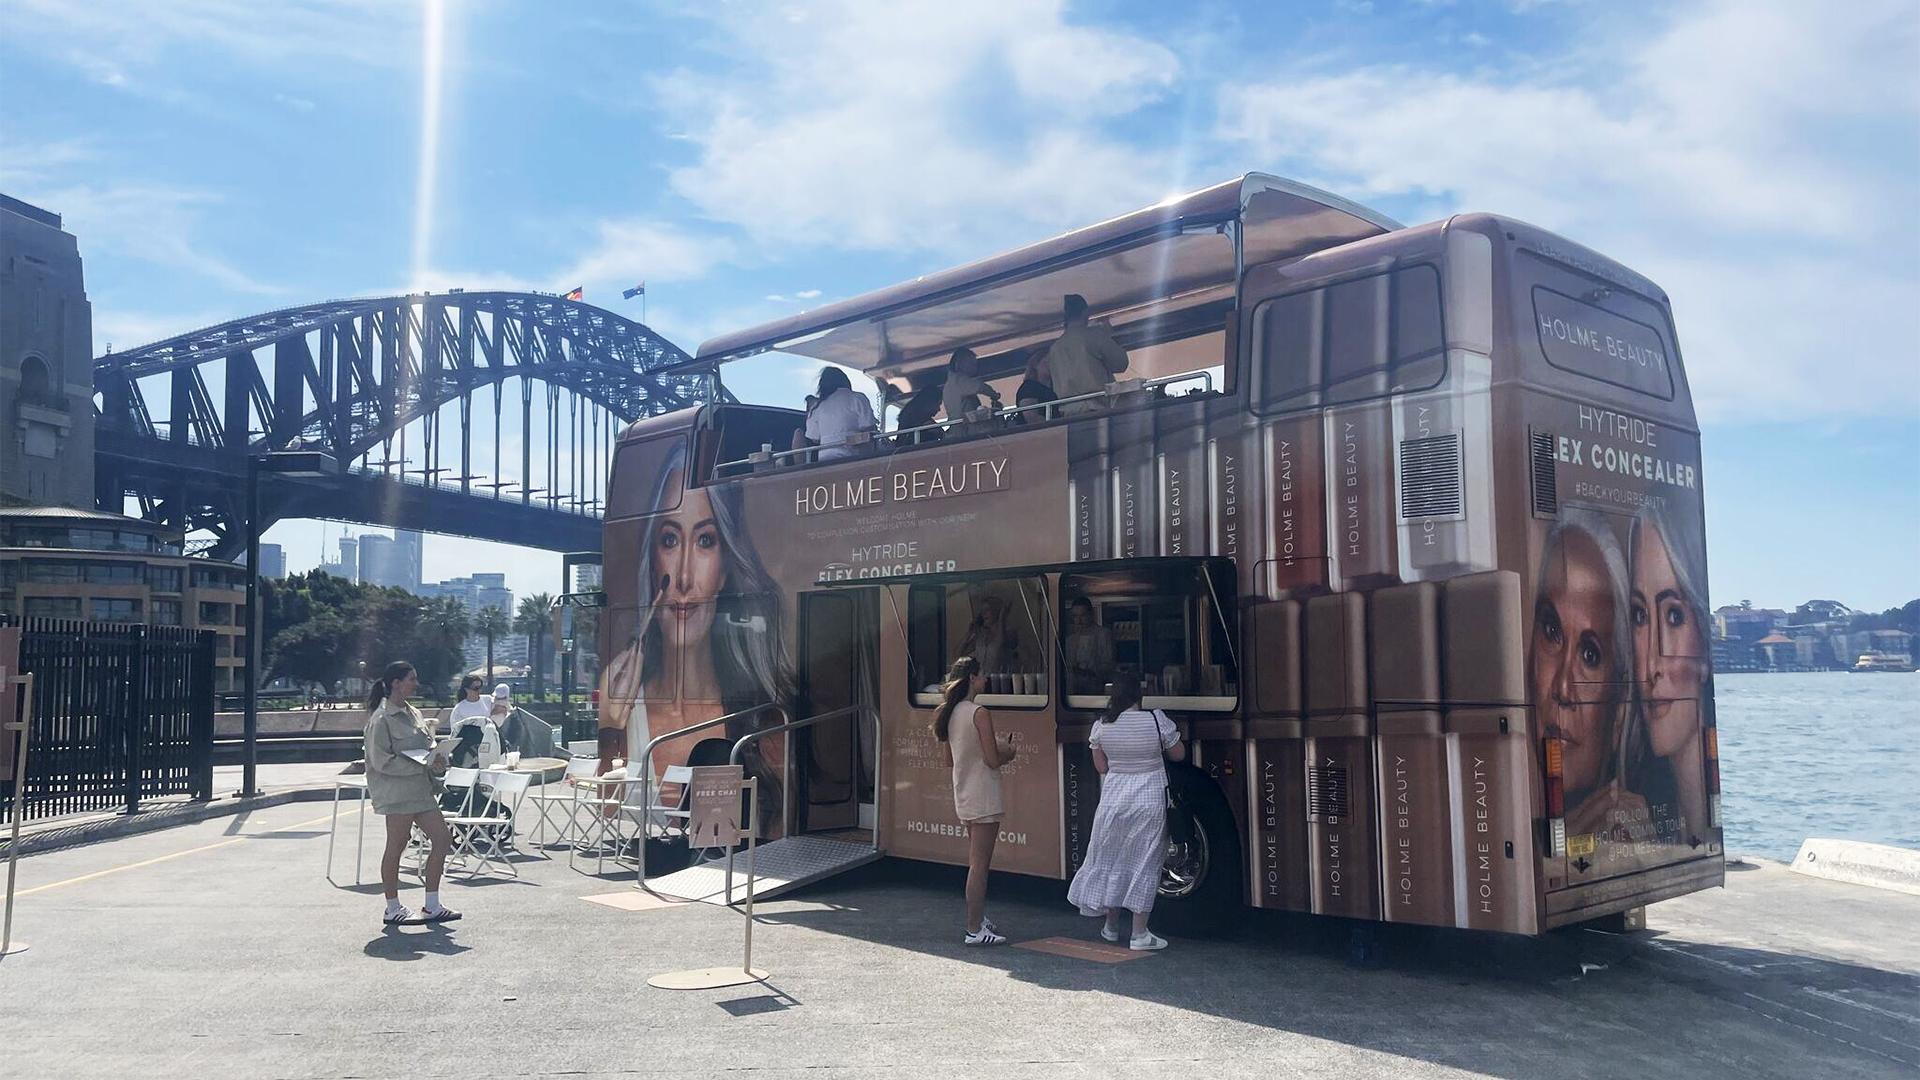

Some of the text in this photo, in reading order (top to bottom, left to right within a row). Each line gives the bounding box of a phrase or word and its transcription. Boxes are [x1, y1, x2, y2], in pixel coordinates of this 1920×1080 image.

[1540, 314, 1665, 372] HOLME BEAUTY
[1578, 404, 1657, 448] HYTRIDE
[795, 458, 1008, 516] HOLME BEAUTY
[1224, 455, 1236, 516] BEAUTY
[1344, 421, 1361, 556] HOLME BEAUTY
[1591, 444, 1696, 489] CONCEALER
[1081, 495, 1089, 547] BEAUTY
[1124, 482, 1134, 537] BEAUTY
[1170, 469, 1182, 527] BEAUTY
[1281, 440, 1295, 567] HOLME BEAUTY
[1575, 481, 1666, 510] #BACKYOURBEAUTY
[851, 541, 919, 562] HYTRIDE
[859, 561, 956, 579] CONCEALER
[696, 790, 716, 798] FREE
[1069, 763, 1079, 872] HOLME BEAUTY
[1652, 803, 1668, 817] THE
[907, 819, 1027, 846] HOLMEBEA.COM
[1263, 760, 1278, 896] HOLME BEAUTY
[1325, 757, 1341, 897] HOLME BEAUTY
[1395, 755, 1412, 906] HOLME BEAUTY
[1474, 756, 1492, 914] HOLME BEAUTY
[1595, 826, 1626, 847] HOLME
[1665, 816, 1686, 832] TOUR
